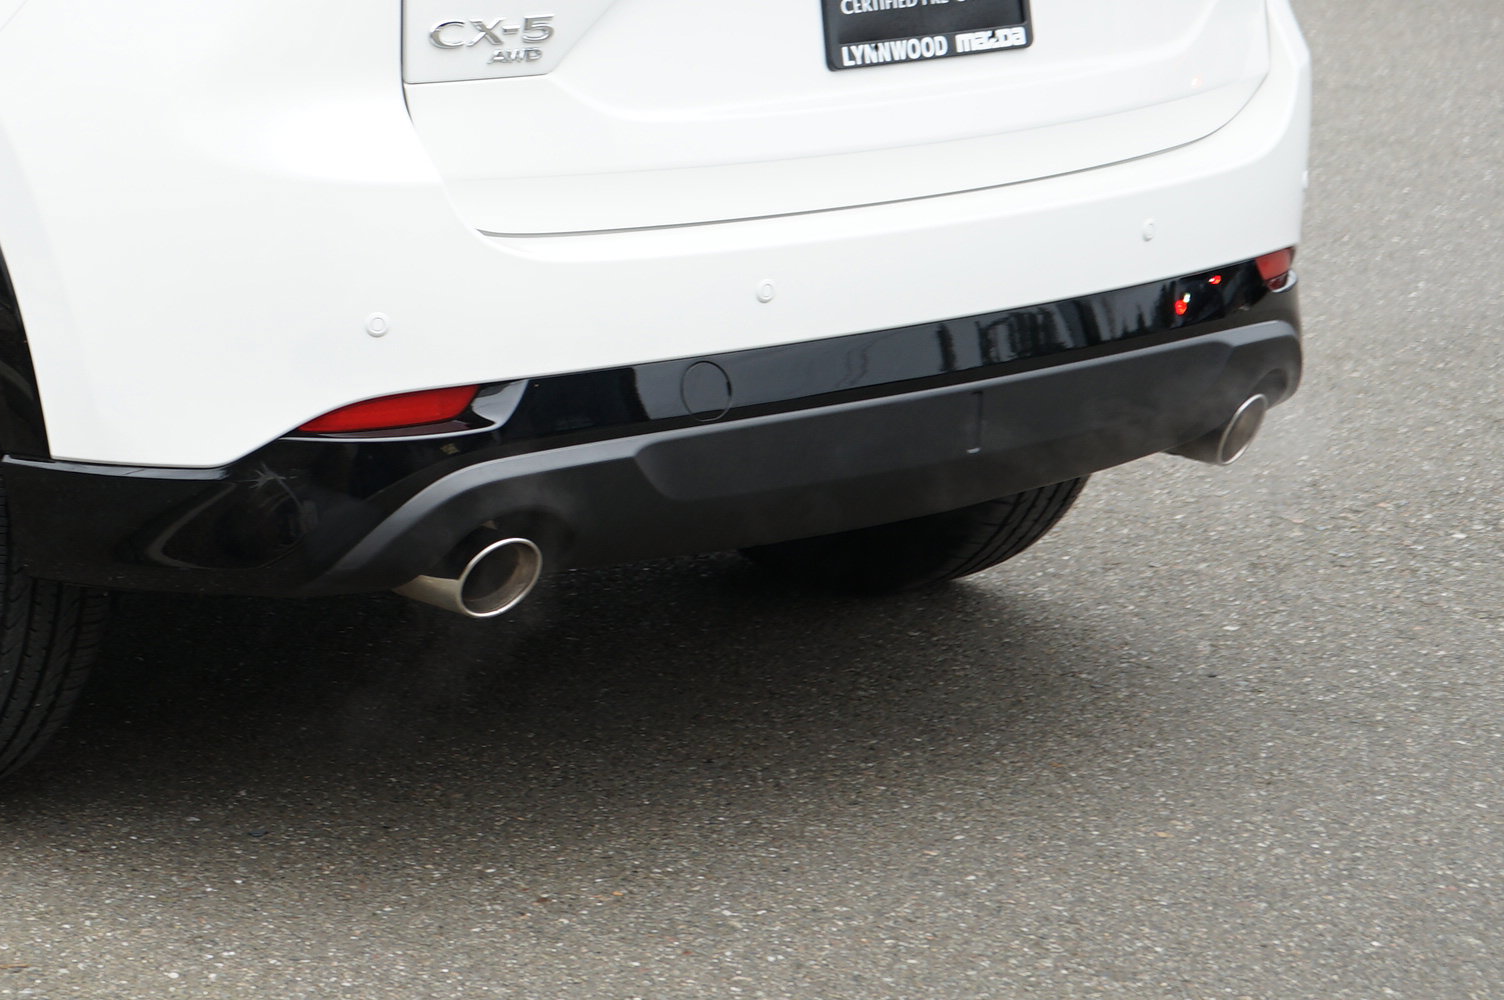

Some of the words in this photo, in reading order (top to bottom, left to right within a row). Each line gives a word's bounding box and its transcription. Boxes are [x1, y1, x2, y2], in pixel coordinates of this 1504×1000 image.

[429, 14, 554, 49] CX-5
[487, 47, 543, 64] AWD
[841, 36, 948, 66] LYNNWOOD
